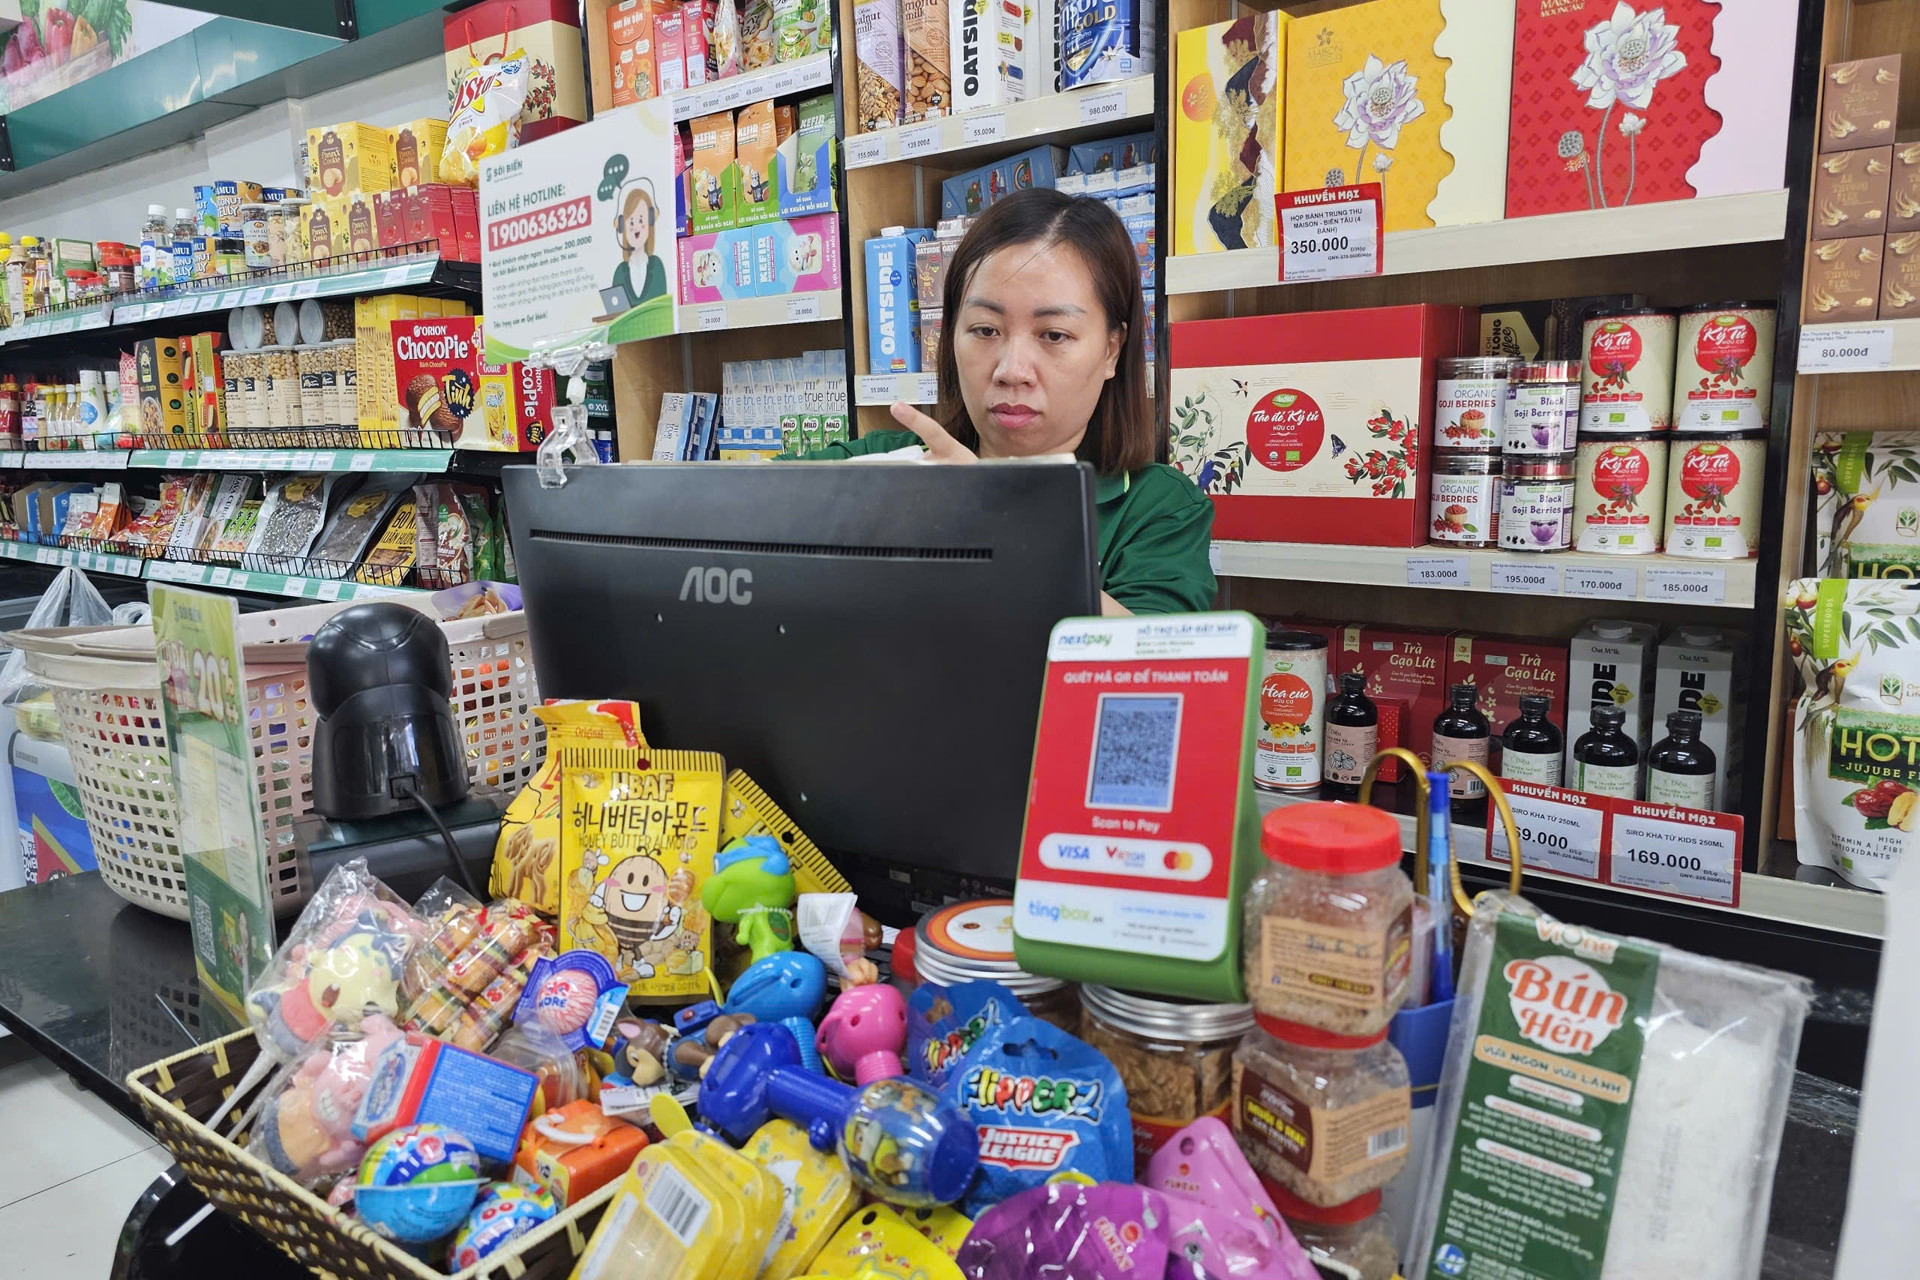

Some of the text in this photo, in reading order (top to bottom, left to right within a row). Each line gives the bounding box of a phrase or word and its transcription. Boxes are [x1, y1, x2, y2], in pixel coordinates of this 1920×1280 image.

[906, 7, 925, 20] milk
[1075, 6, 1117, 33] GOLD
[857, 21, 873, 35] milk
[1089, 104, 1117, 116] 980.000đ
[973, 127, 996, 137] 55.000đ
[488, 184, 566, 217] LIÊN HỆ HOTLINE:
[1293, 189, 1360, 205] KHUYẾN MẠI
[1325, 209, 1348, 218] TRUNG
[491, 201, 588, 248] 1900636326
[1293, 221, 1319, 229] MAISON
[1290, 236, 1349, 255] 350.000
[740, 240, 751, 286] KEFIR
[758, 237, 768, 283] KEFIR
[879, 252, 896, 355] OATSIDE
[1492, 318, 1501, 348] LONG
[397, 334, 468, 361] ChocoPie
[1821, 347, 1869, 358] 80.000đ
[827, 380, 839, 390] TH
[827, 390, 847, 402] true
[1454, 389, 1497, 399] ORGANIC
[1540, 396, 1564, 405] Black
[827, 401, 846, 412] MILK
[1439, 399, 1496, 408] GOJI BERRIES
[1514, 408, 1564, 419] Goji Berries
[783, 421, 796, 429] MILO
[803, 421, 818, 429] MILO
[826, 421, 840, 429] MILO
[1440, 484, 1479, 495] ORGANIC
[1441, 495, 1479, 504] BERRIES
[1539, 494, 1562, 503] Black
[1512, 505, 1561, 515] Goji Berries
[1420, 569, 1458, 579] 183.000đ
[1505, 575, 1546, 585] 195.000đ
[679, 566, 753, 606] AOC
[1579, 580, 1623, 590] 170.000đ
[1662, 583, 1709, 593] 185.000đ
[1822, 598, 1834, 649] SUPERFOODS
[1058, 632, 1114, 647] nextpay
[1403, 641, 1423, 655] Trà
[1389, 654, 1437, 669] Gạo Lứt
[1520, 653, 1542, 667] Trà
[1063, 669, 1093, 684] QUÉT
[1151, 671, 1192, 683] THANH
[1193, 669, 1229, 683] TOÁN
[1504, 665, 1557, 682] Gạo Lứt
[1261, 682, 1310, 699] Hoa cúc
[575, 725, 604, 741] Original
[610, 771, 675, 802] HBAF
[1511, 783, 1587, 806] KHUYẾN MẠI
[573, 801, 709, 838] 허니버터아몬드
[1511, 807, 1528, 817] SIRO
[1529, 811, 1546, 820] KHA
[1558, 817, 1581, 828] 250ML
[1632, 805, 1716, 826] KHUYẾN MẠI
[1092, 816, 1160, 834] Scan to Pay
[579, 833, 698, 850] HONEY BUTTER ALMOND
[1503, 825, 1568, 850] 69.000
[1625, 828, 1645, 837] SIRO
[1646, 832, 1663, 840] KHA
[1677, 835, 1698, 845] KIDS
[1699, 839, 1725, 848] 250ML
[1878, 835, 1903, 846] HIGH
[1057, 844, 1091, 860] VISA
[1830, 840, 1891, 861] ANTIOXIDANTS
[1627, 848, 1701, 872] 169.000
[1505, 959, 1627, 1026] Bún
[1519, 1007, 1595, 1053] Hến
[1510, 1053, 1550, 1072] NGON
[982, 1127, 1065, 1150] JUSTICE
[980, 1143, 1057, 1164] LEAGUE
